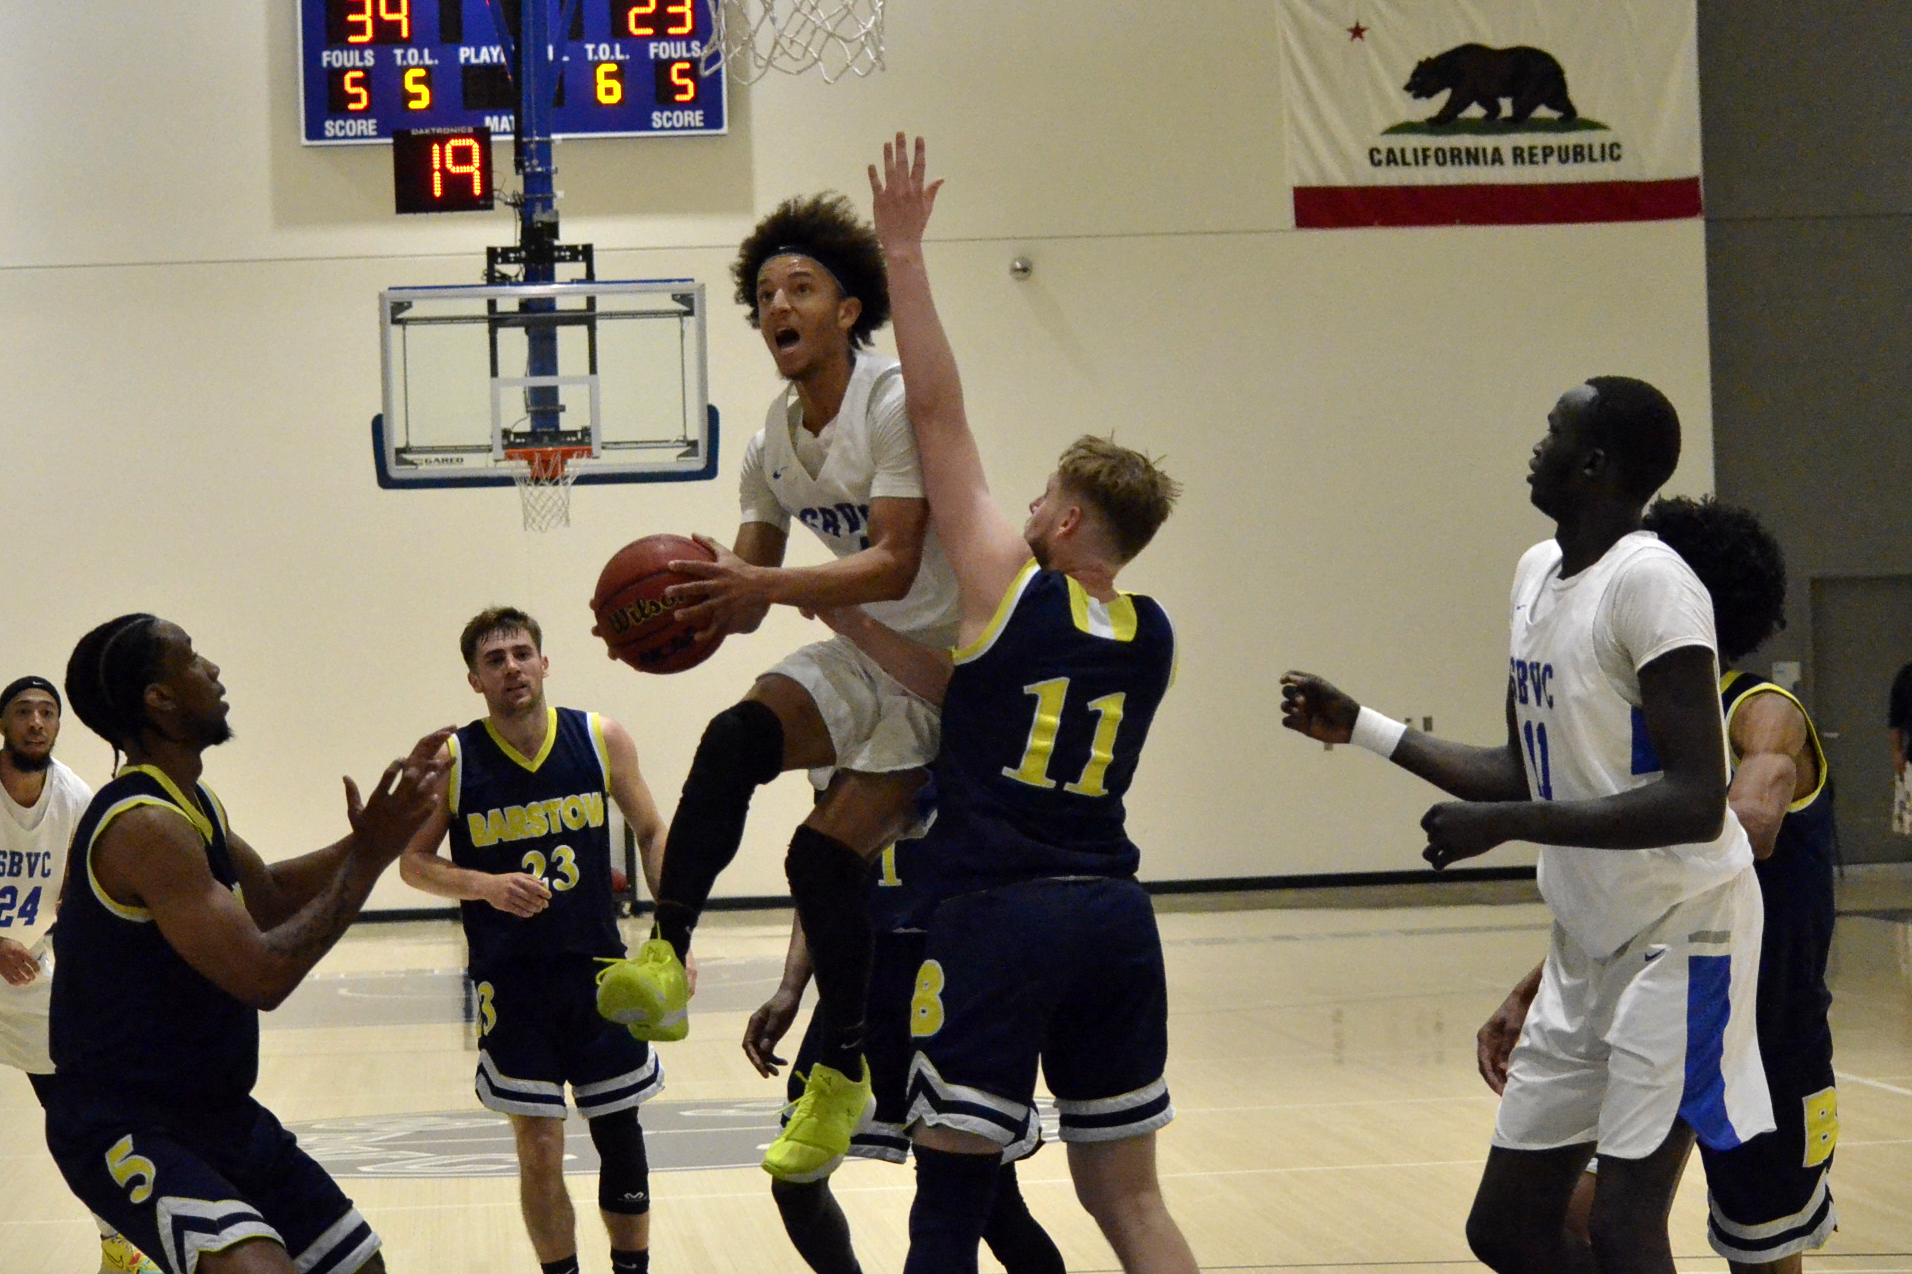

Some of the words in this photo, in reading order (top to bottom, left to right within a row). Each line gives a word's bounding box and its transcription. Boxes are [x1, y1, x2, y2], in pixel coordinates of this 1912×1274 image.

[346, 0, 411, 43] 34
[628, 0, 693, 36] 23
[322, 49, 375, 67] FOULS
[393, 48, 439, 65] T.O.L.
[584, 43, 630, 61] T.O.L.
[649, 41, 702, 59] FOULS
[344, 70, 369, 110] 5
[404, 68, 430, 109] 5
[596, 63, 622, 104] 6
[670, 61, 694, 102] 5
[324, 119, 377, 137] SCORE
[651, 111, 704, 128] SCORE
[432, 138, 481, 198] 19
[1369, 147, 1505, 168] CALIFORNIA
[1512, 142, 1622, 166] REPUBLIC
[1002, 676, 1126, 796] 11
[467, 791, 605, 848] BARSTOW
[0, 850, 52, 879] SBVC
[522, 845, 580, 892] 23
[0, 885, 42, 928] 24
[910, 959, 945, 1037] B
[106, 1134, 156, 1204] 5
